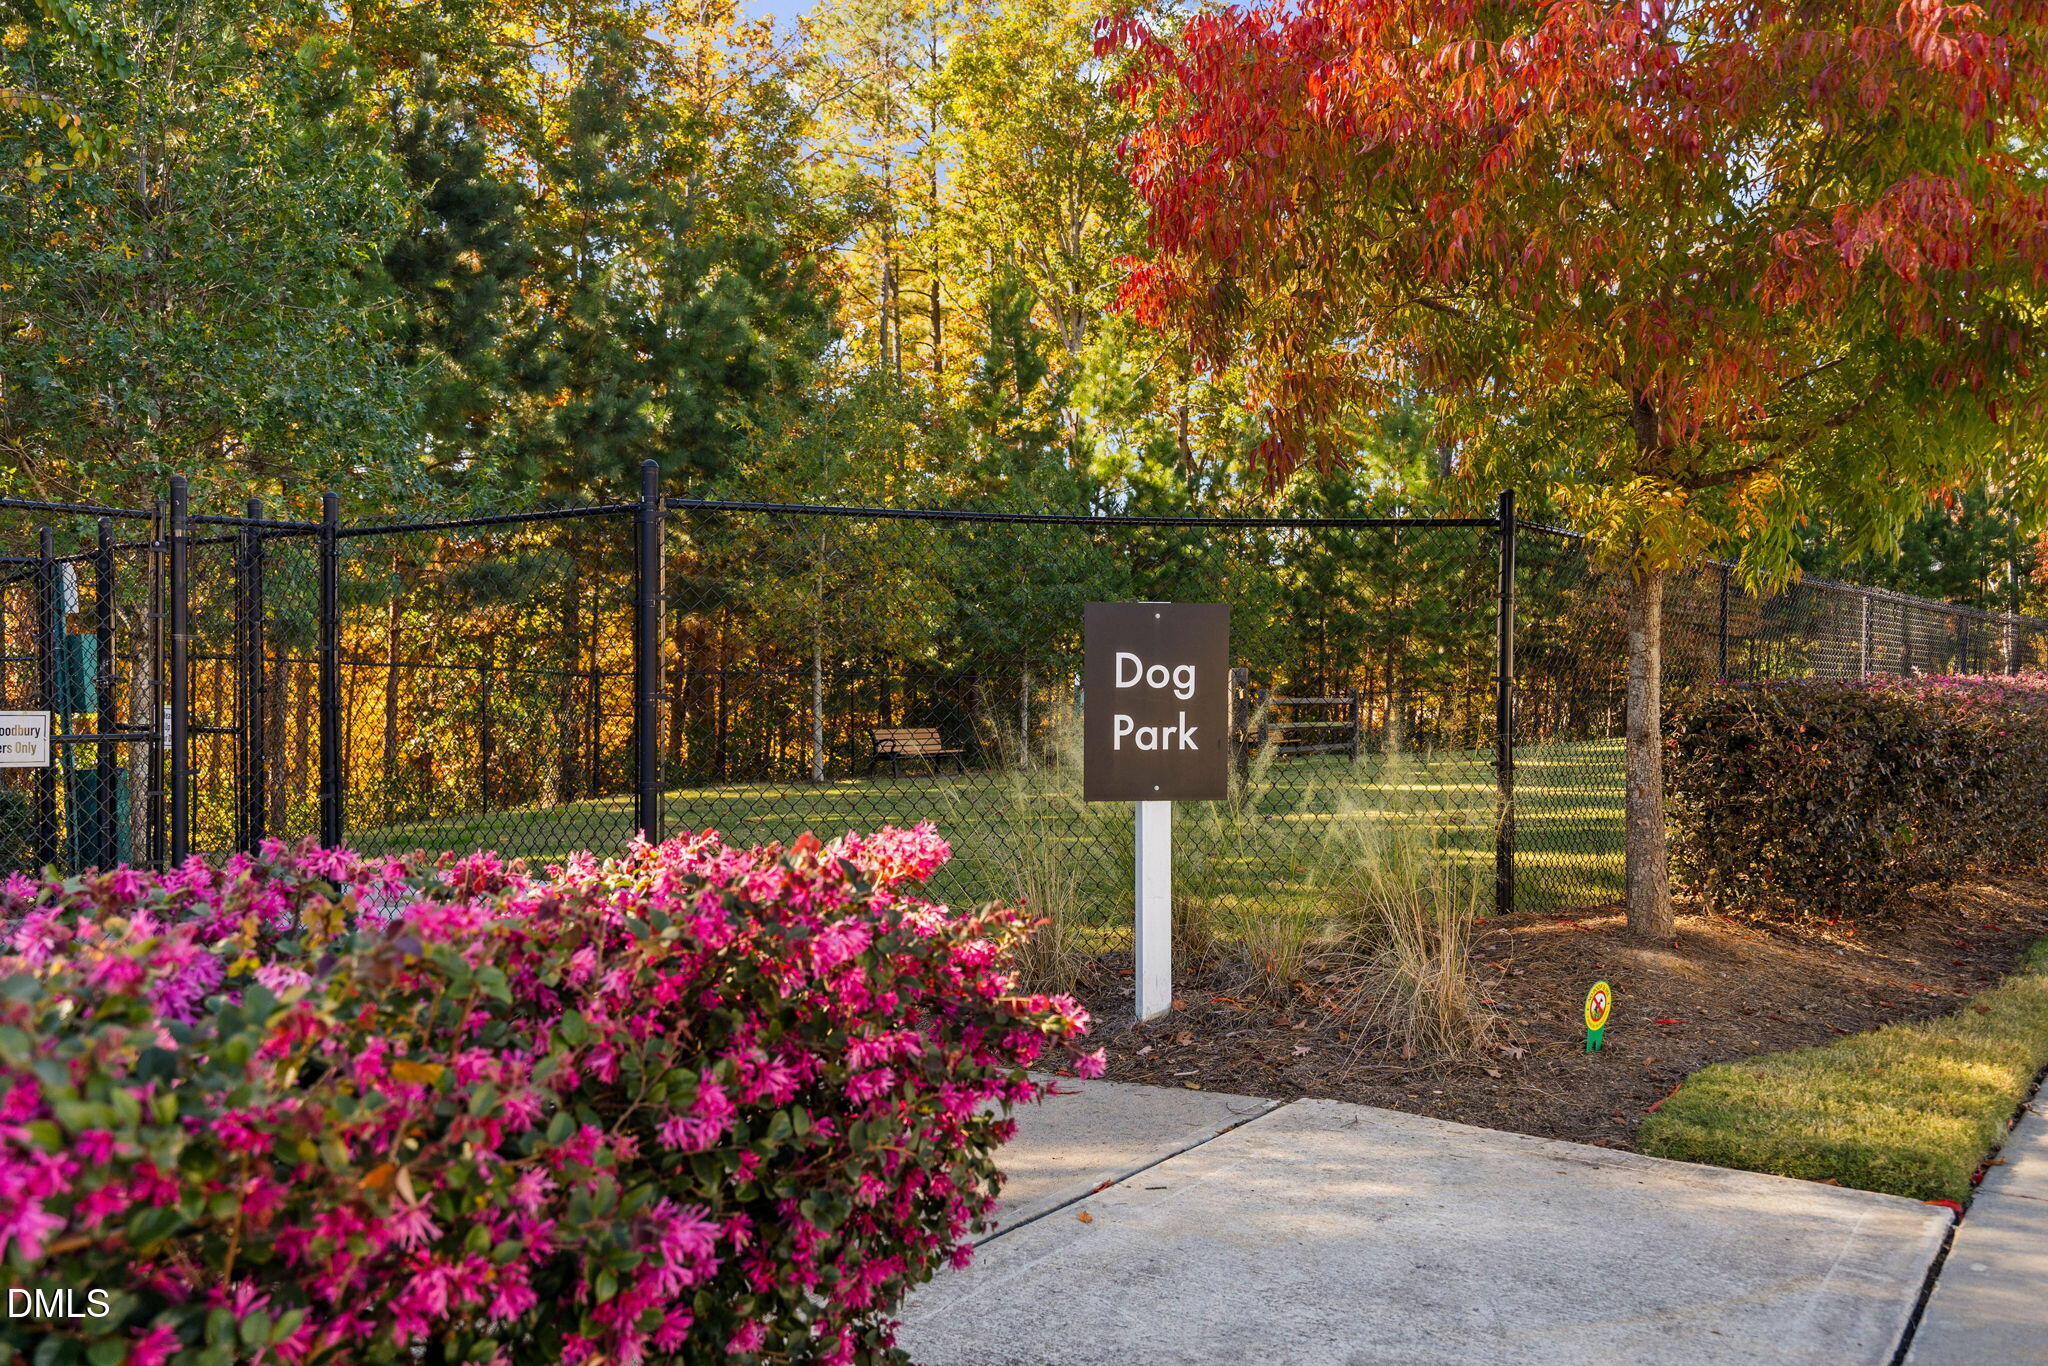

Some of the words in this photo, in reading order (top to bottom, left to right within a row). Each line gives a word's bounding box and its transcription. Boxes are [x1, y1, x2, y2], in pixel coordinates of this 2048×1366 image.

[1115, 652, 1196, 700] Dog
[15, 741, 37, 756] Only
[1113, 711, 1199, 751] Park
